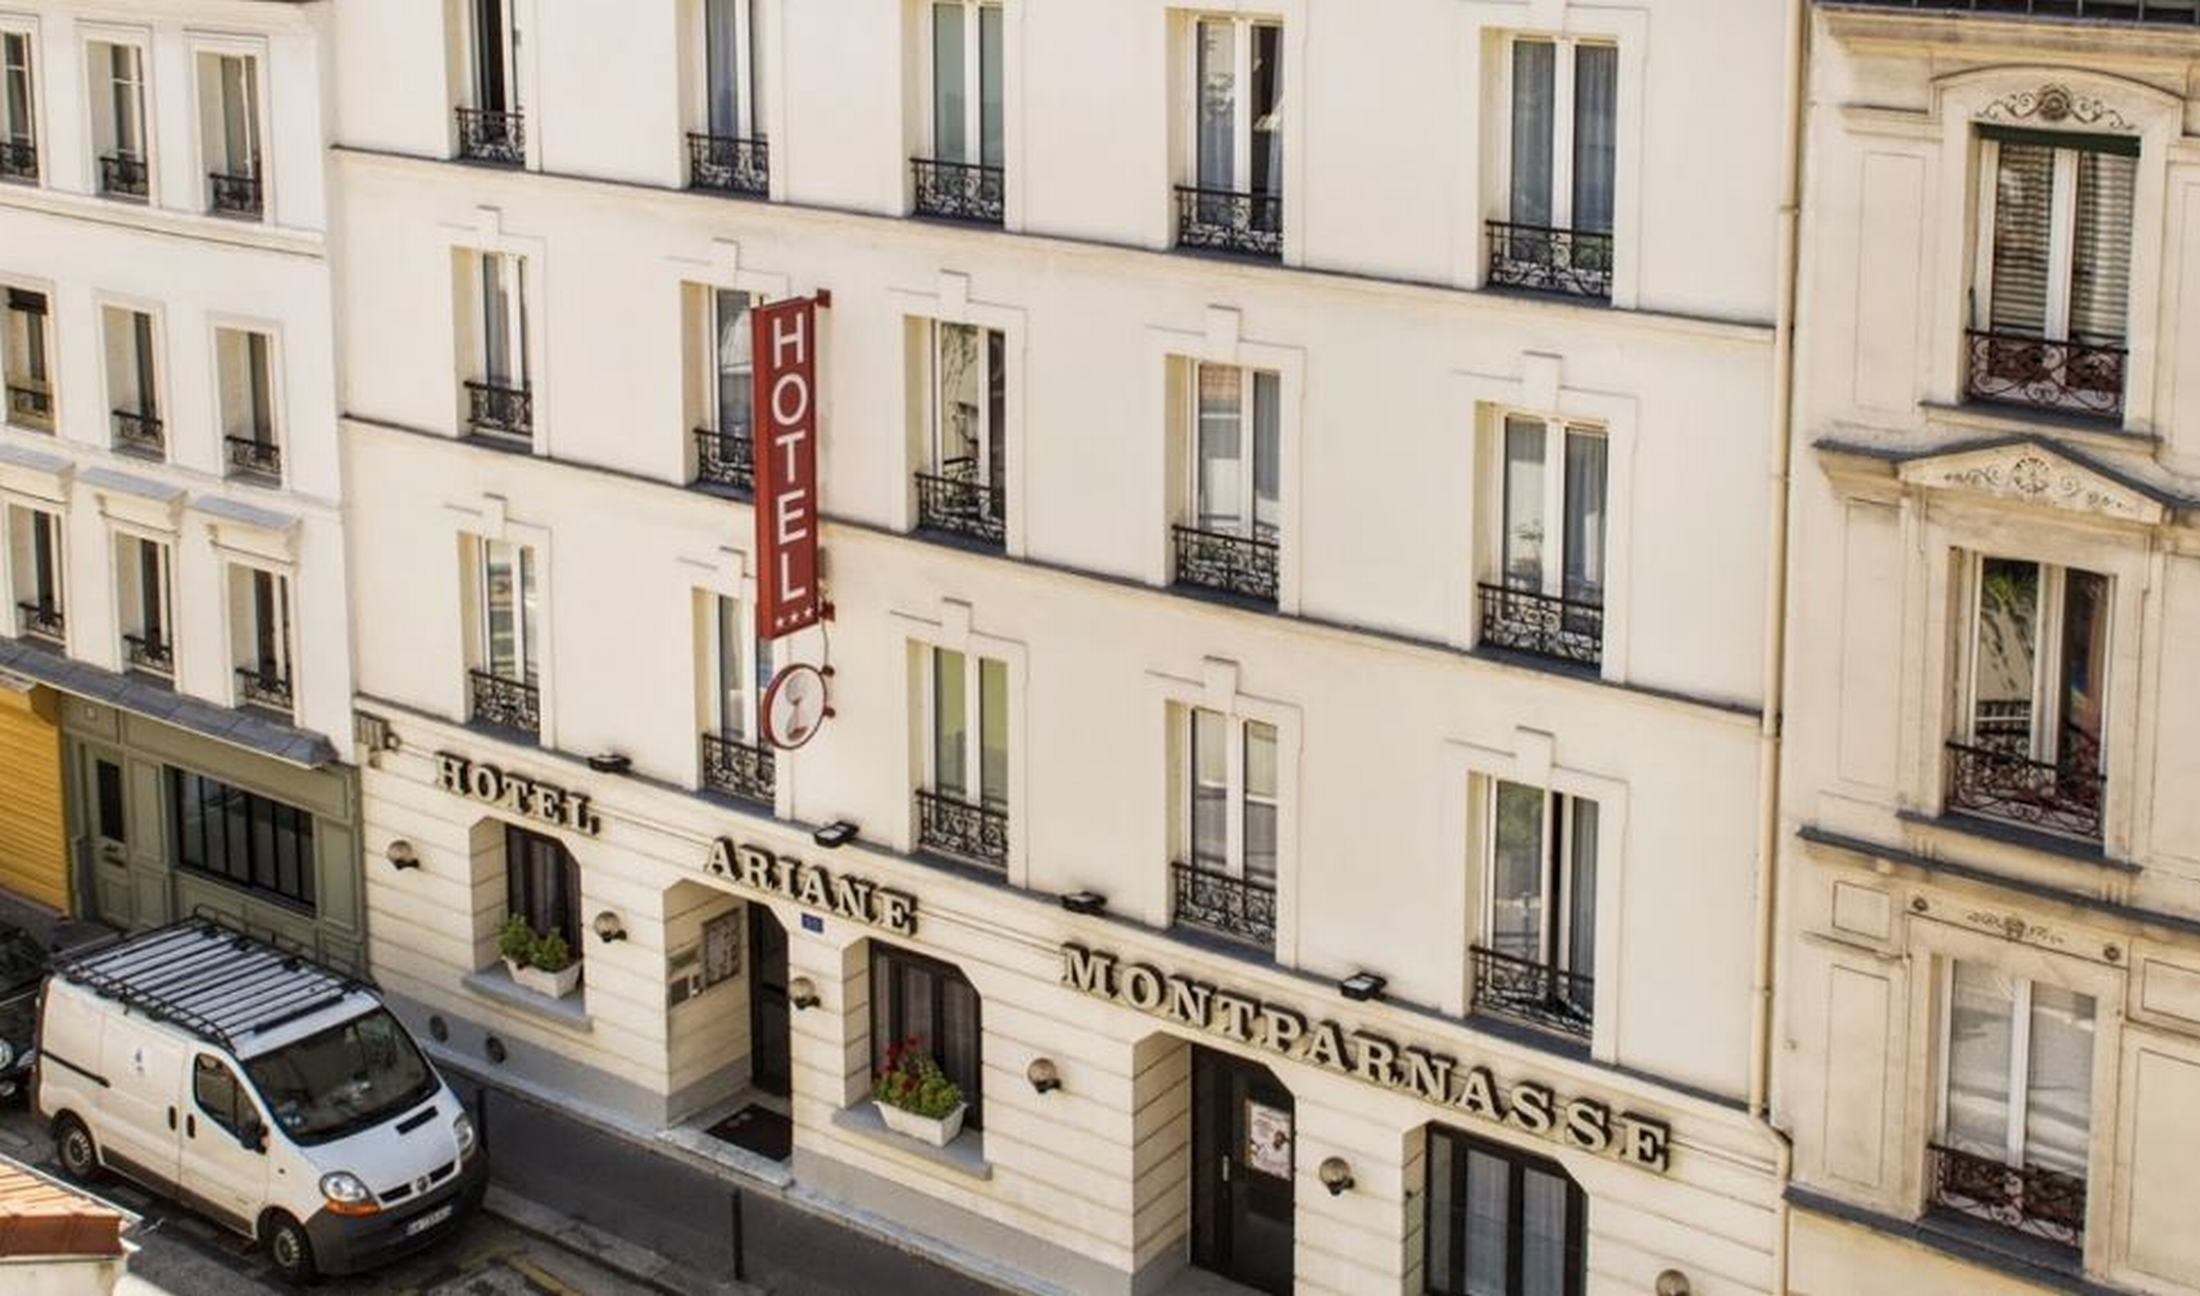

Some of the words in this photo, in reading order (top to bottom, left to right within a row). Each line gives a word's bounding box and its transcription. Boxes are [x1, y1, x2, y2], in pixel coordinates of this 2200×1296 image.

[771, 312, 808, 602] HOTEL
[434, 751, 601, 837] HOTEL
[703, 836, 918, 936] ARIANE
[1059, 942, 1672, 1174] MONTPARNASSE
